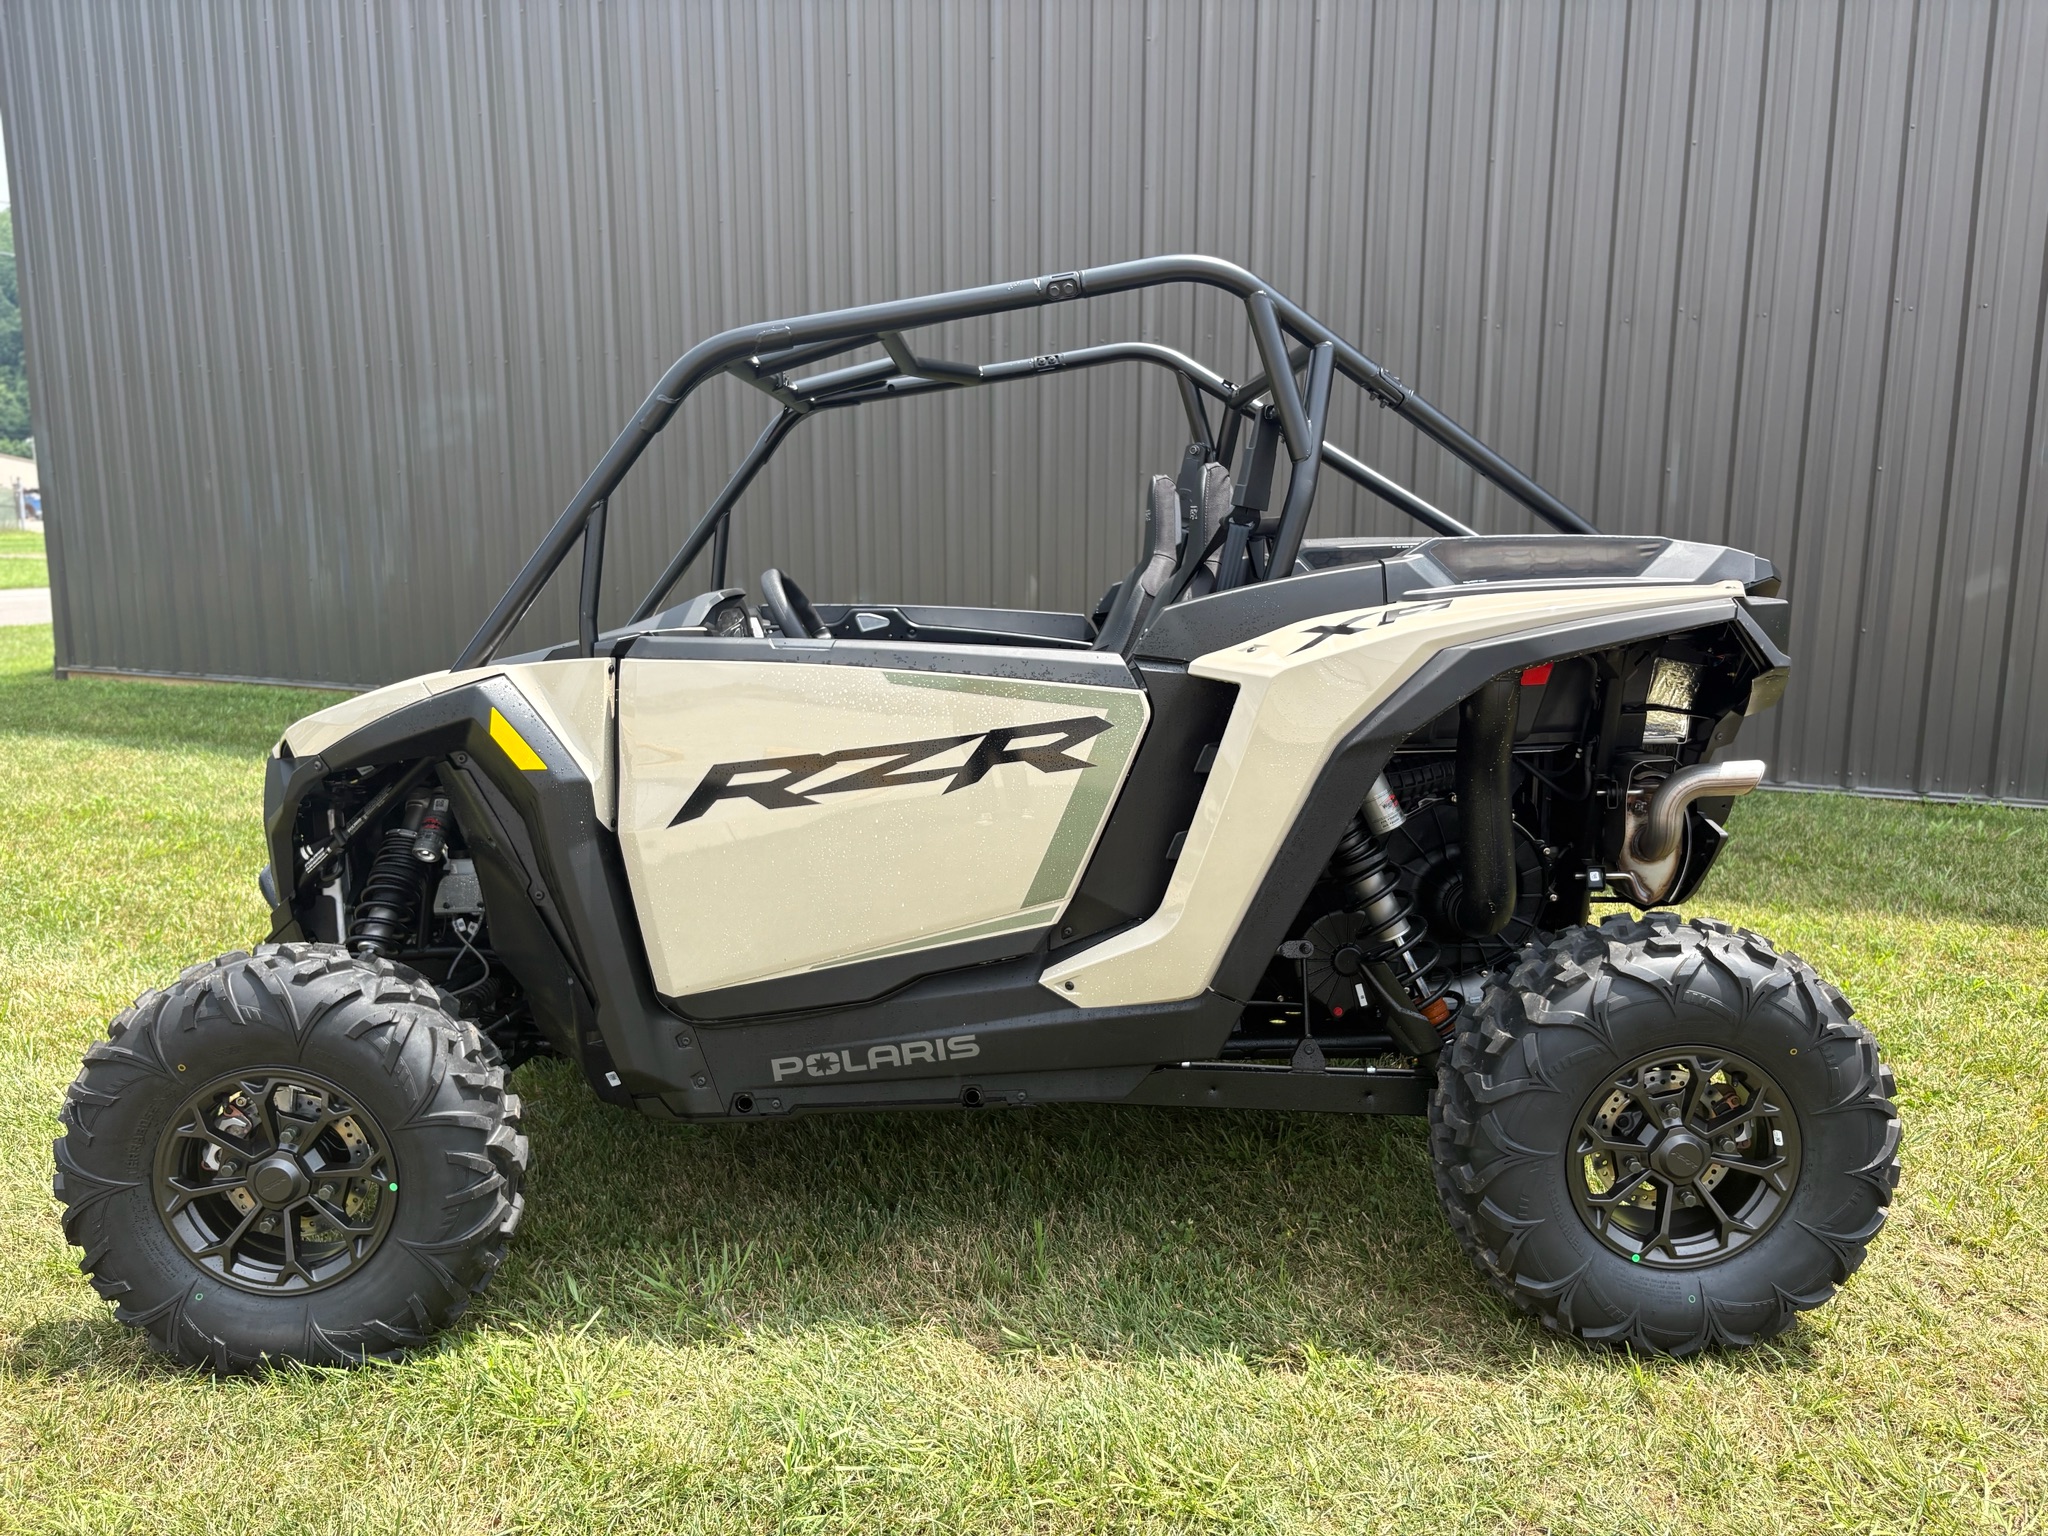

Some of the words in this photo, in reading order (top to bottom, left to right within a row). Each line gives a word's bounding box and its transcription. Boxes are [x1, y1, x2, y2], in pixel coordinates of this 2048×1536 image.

[1286, 600, 1454, 656] XP
[666, 716, 1115, 829] RZR
[770, 1034, 981, 1082] POLARIS
